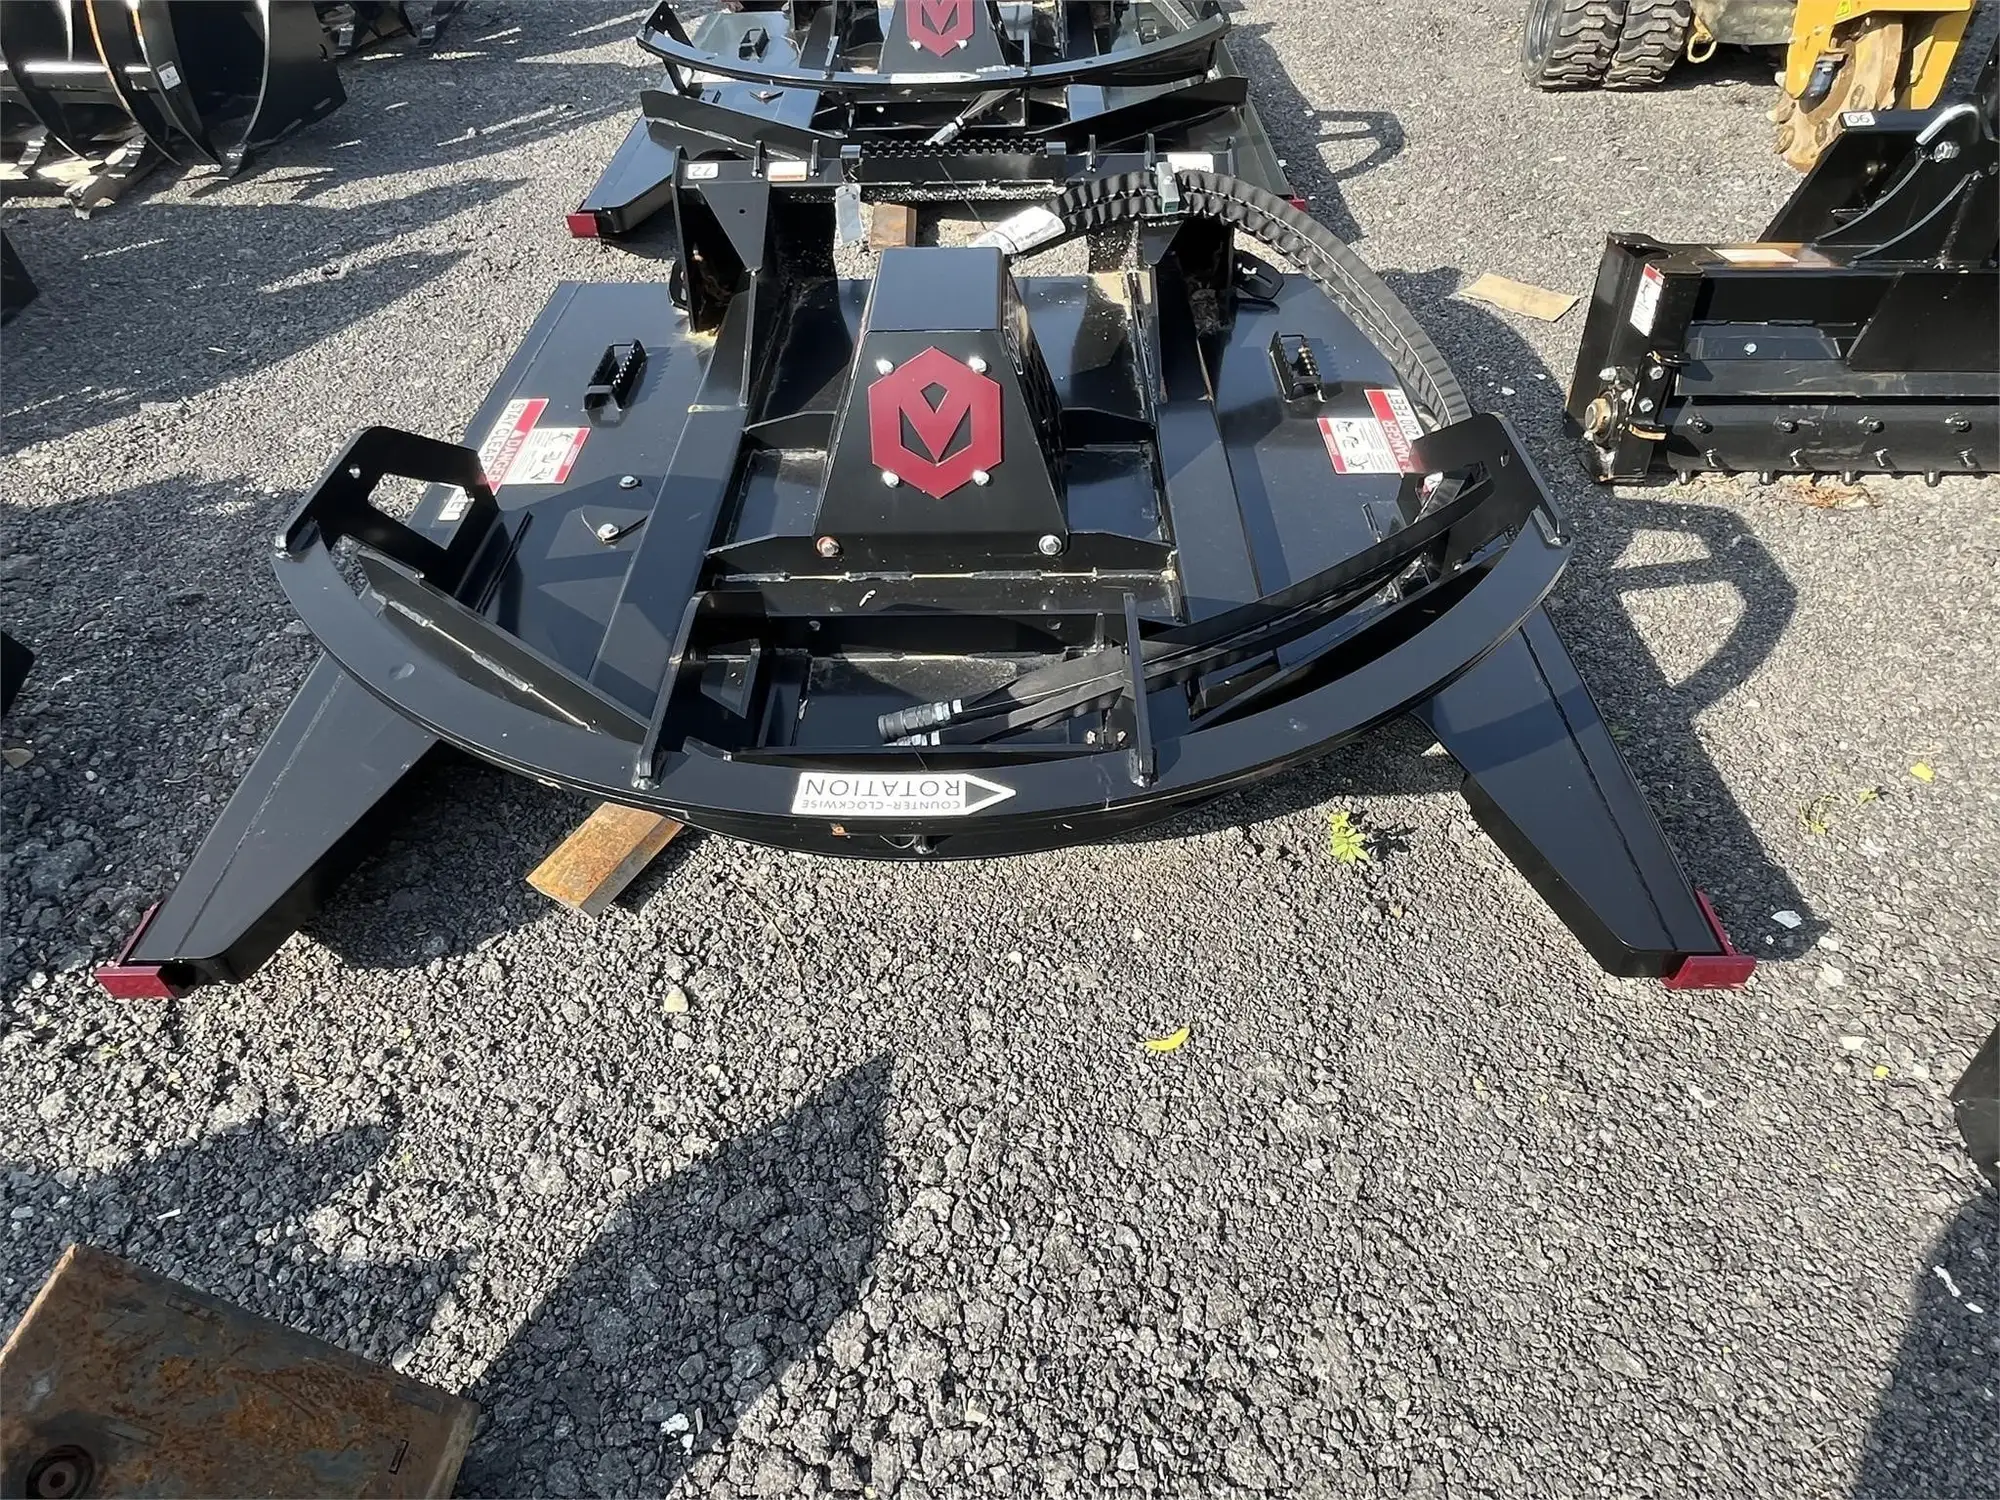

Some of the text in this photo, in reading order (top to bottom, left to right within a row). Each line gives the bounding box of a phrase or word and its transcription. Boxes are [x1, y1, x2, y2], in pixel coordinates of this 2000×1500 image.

[691, 165, 714, 177] 72
[502, 402, 526, 426] STAY
[1388, 393, 1420, 438] 200 FEET
[484, 428, 508, 463] CLEAR
[1383, 420, 1410, 462] DANGER
[488, 436, 523, 482] DANGER
[805, 778, 960, 798] ROTATION
[801, 799, 960, 810] COUNTER-CLOCKWISE
